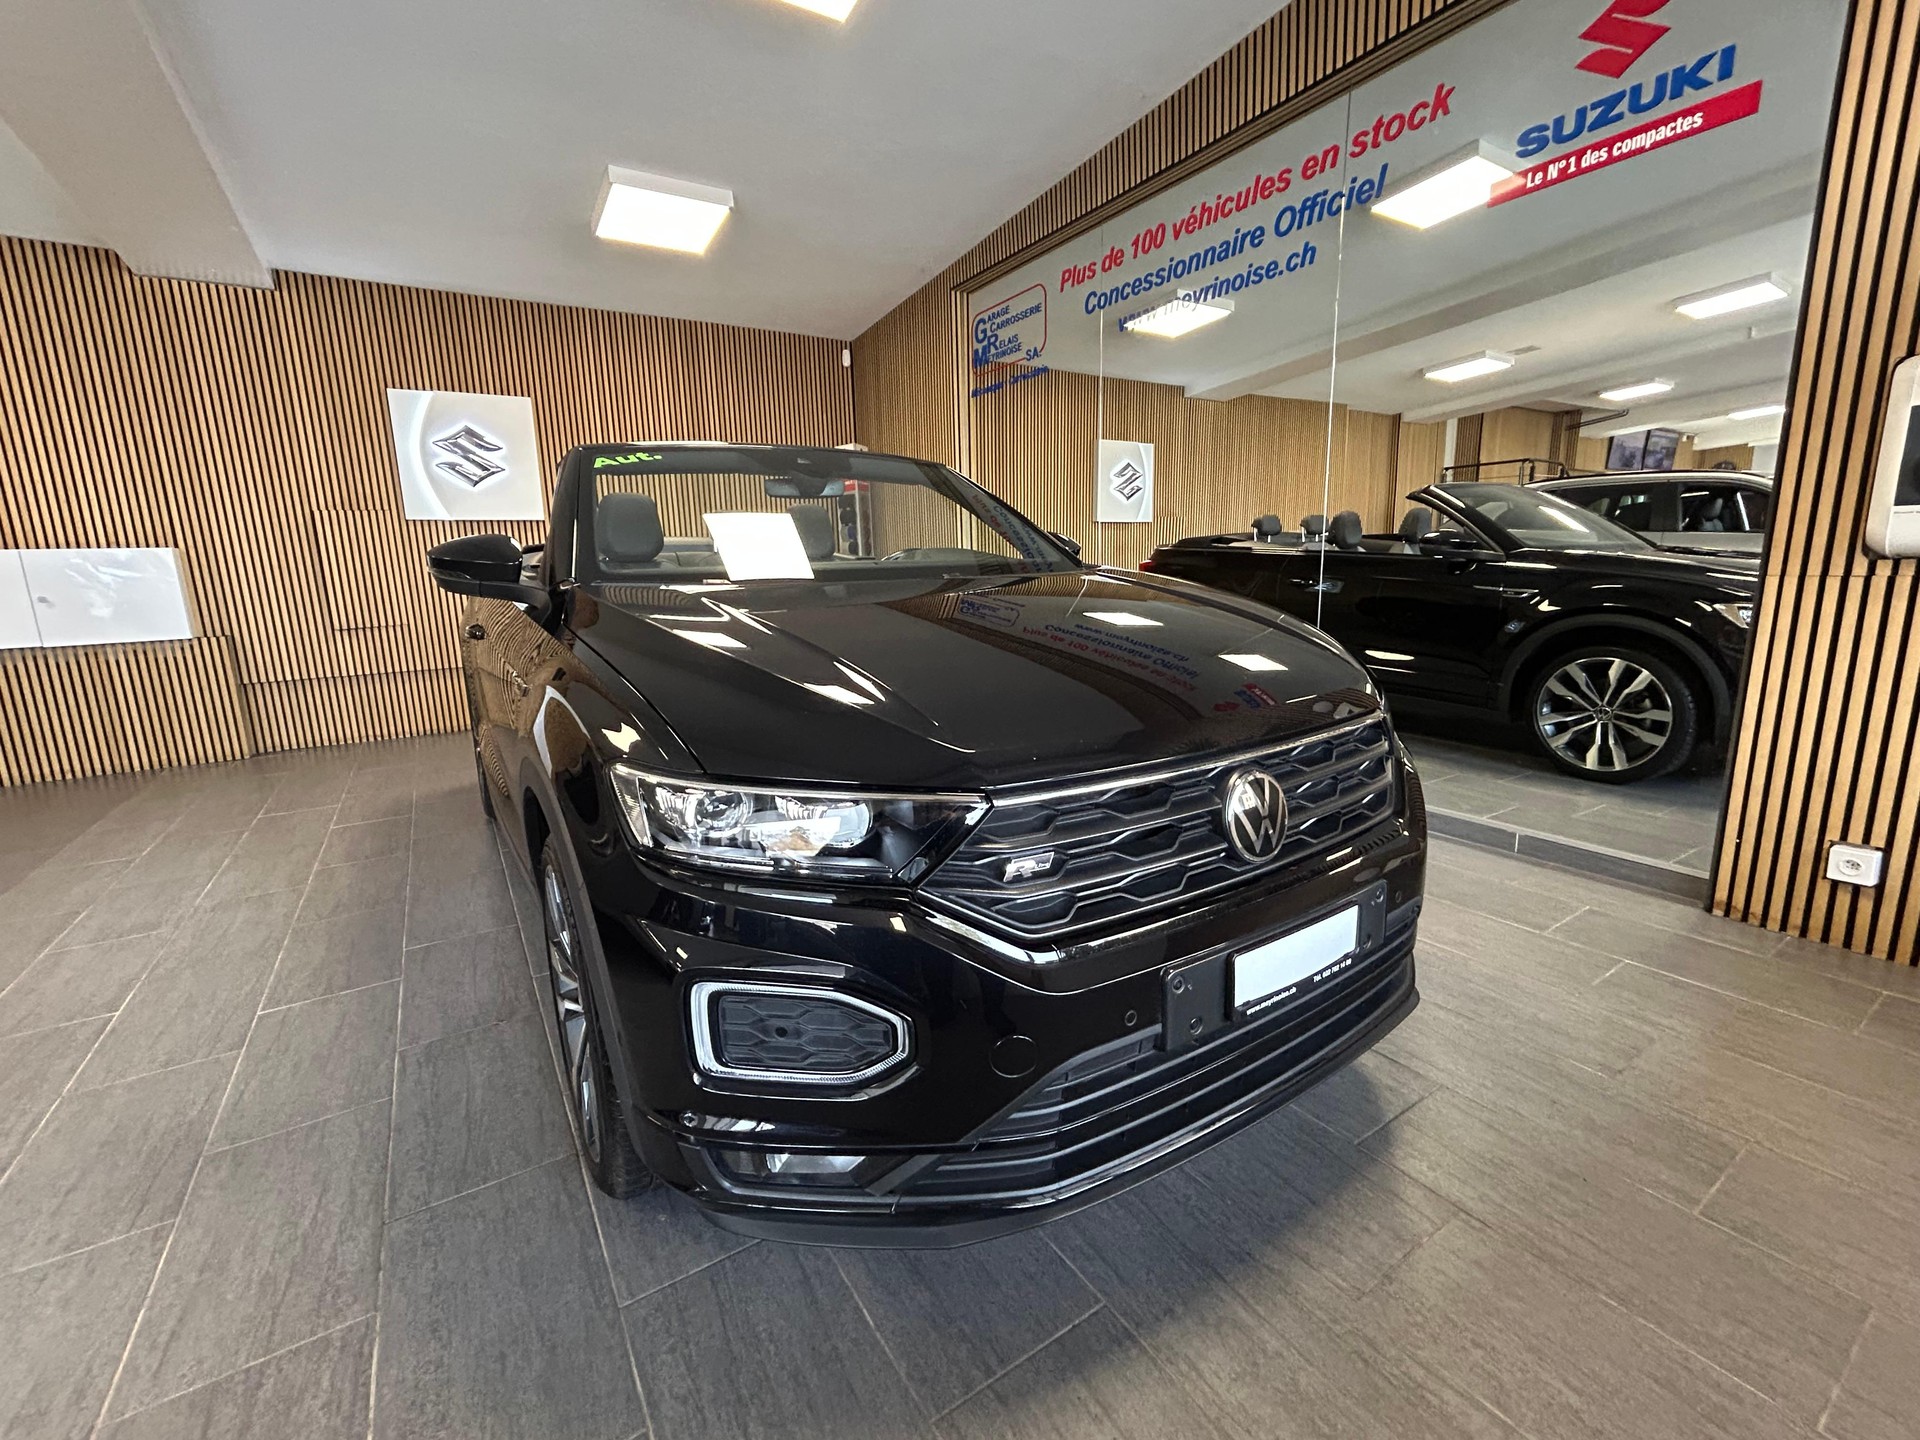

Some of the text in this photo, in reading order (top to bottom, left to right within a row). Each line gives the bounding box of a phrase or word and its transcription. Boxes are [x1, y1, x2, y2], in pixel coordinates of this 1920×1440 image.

[1515, 43, 1737, 159] SUZUKI
[1059, 82, 1457, 293] Plus de 100 véhicules en stock
[1526, 170, 1543, 190] Le
[1581, 148, 1608, 169] des
[1612, 111, 1704, 158] compactes
[1084, 163, 1390, 316] Concessionnaire Officiel
[989, 303, 1042, 332] CARROSSERIE
[593, 452, 663, 468] Aut.
